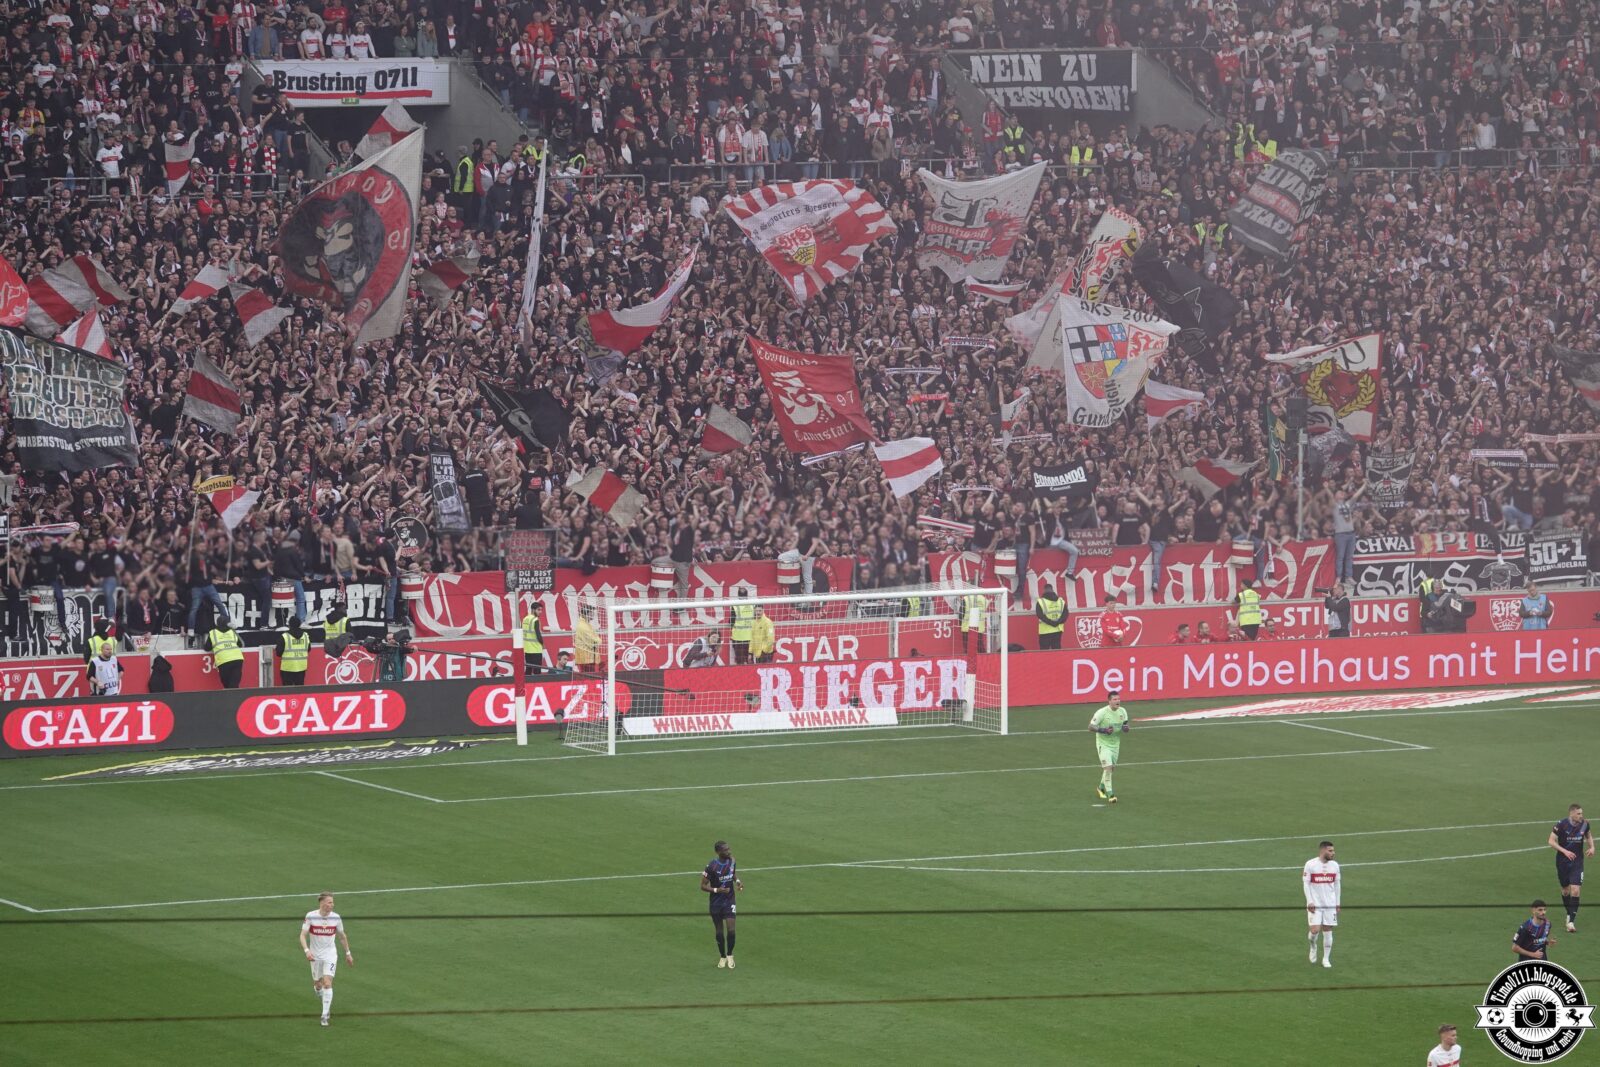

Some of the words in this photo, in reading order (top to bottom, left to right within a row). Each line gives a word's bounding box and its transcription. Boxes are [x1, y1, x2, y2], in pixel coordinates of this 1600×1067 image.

[272, 70, 367, 96] Brustring
[374, 66, 418, 91] 0711
[970, 54, 1042, 83] NEIN
[1060, 54, 1097, 82] ZU
[985, 85, 1130, 112] VESTOREN!
[804, 201, 838, 214] Hessen
[13, 394, 125, 428] IDERSTAND
[836, 390, 855, 407] 97
[75, 435, 126, 451] STUTTGART
[1034, 466, 1087, 486] COMMANDO
[1529, 538, 1587, 566] 50+1
[519, 576, 552, 584] IMMER
[534, 569, 552, 577] BIST
[1263, 544, 1329, 601] 97
[933, 621, 952, 639] 35
[1072, 656, 1164, 695] Dein
[1183, 648, 1411, 690] Möbelhaus
[1428, 641, 1498, 679] mit
[757, 659, 968, 713] RIEGER
[653, 714, 734, 733] WINAMAX
[788, 708, 869, 728] WINAMAX
